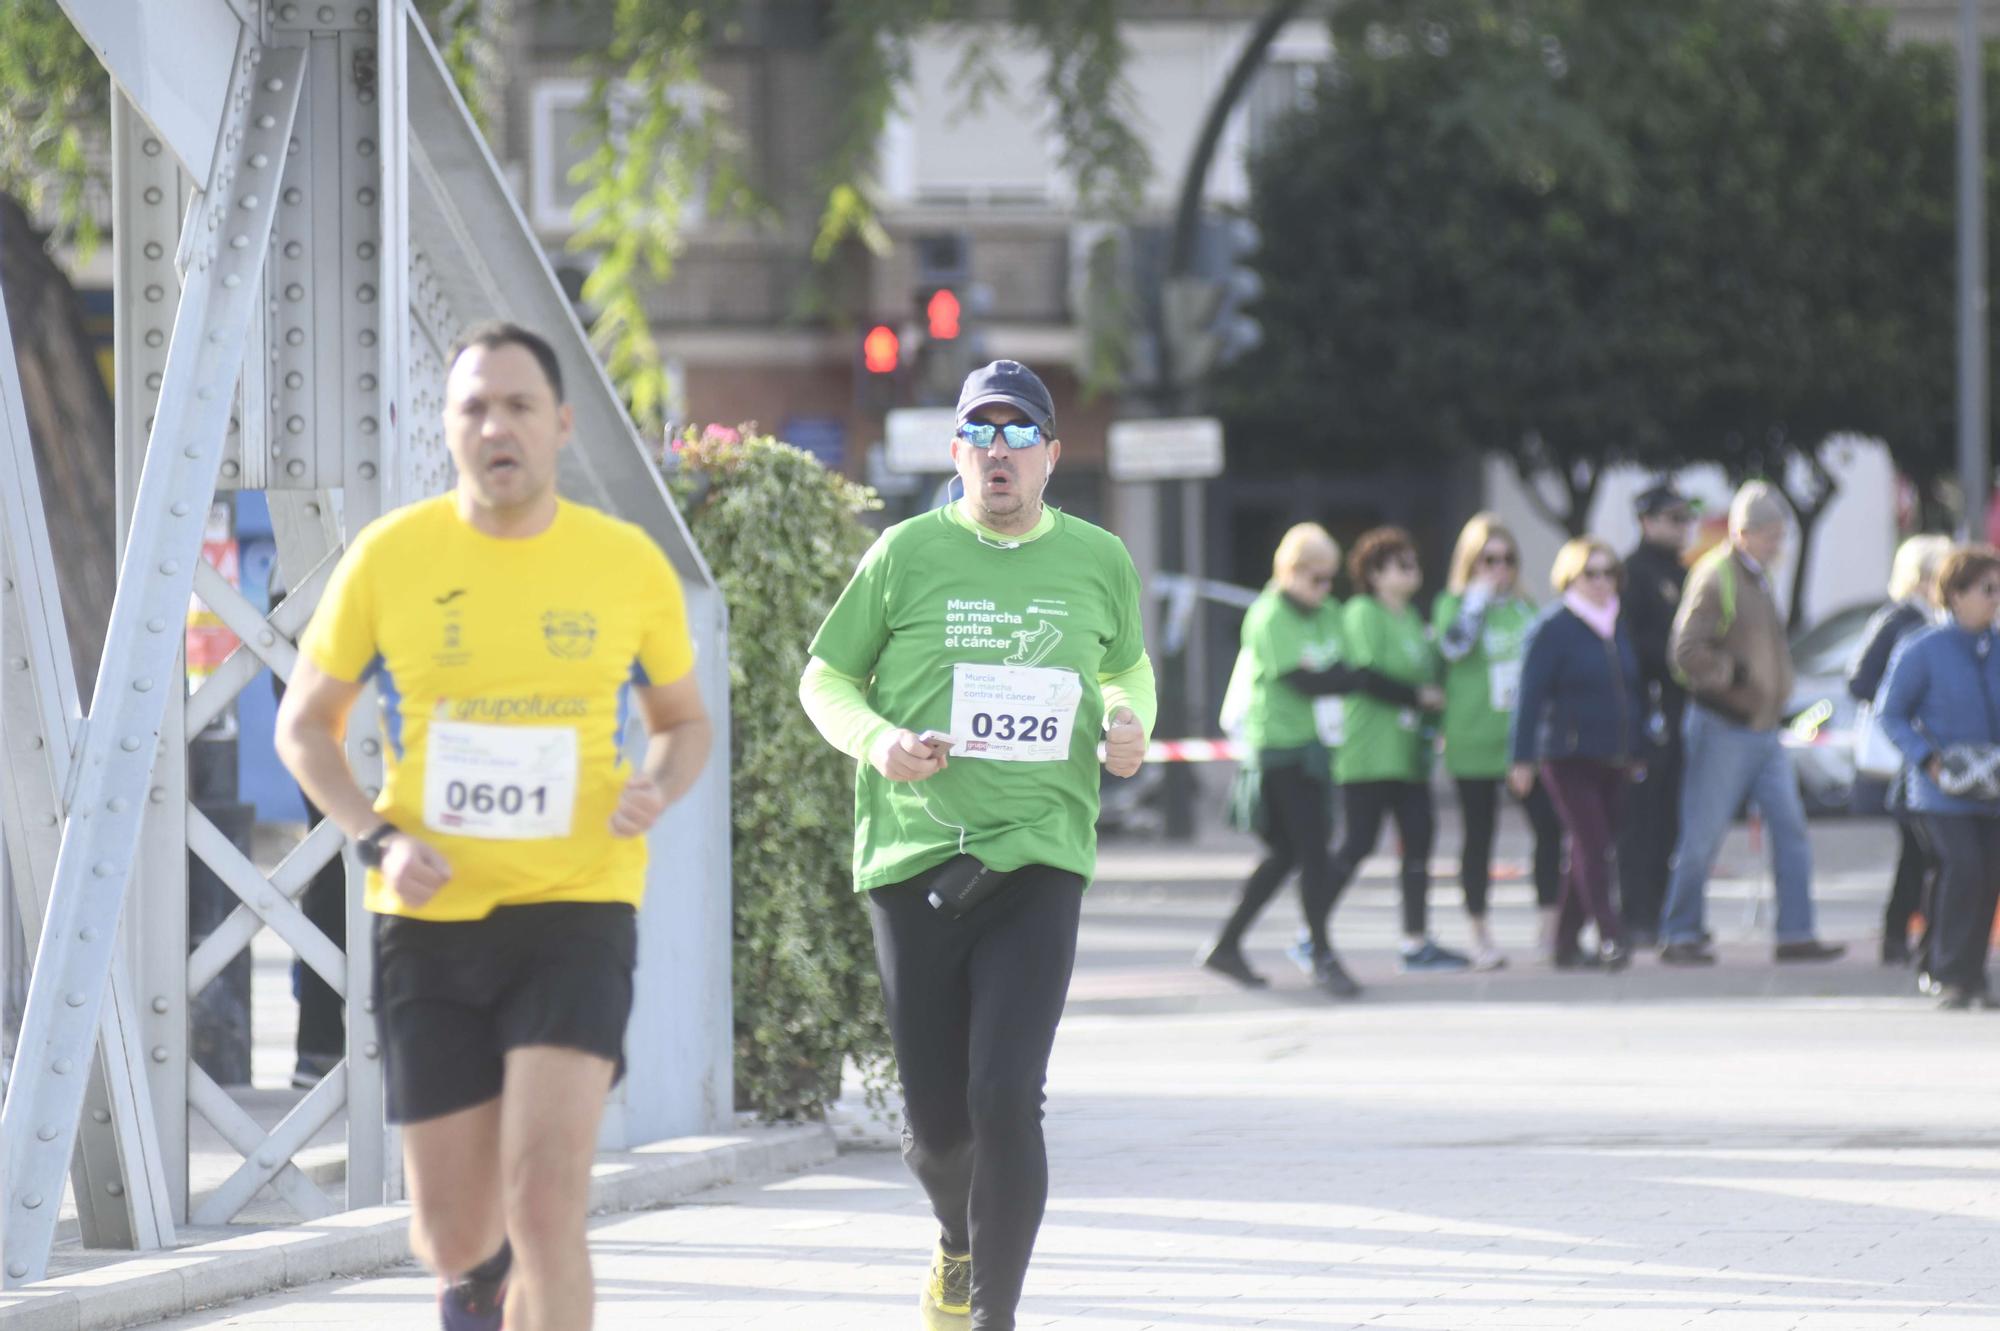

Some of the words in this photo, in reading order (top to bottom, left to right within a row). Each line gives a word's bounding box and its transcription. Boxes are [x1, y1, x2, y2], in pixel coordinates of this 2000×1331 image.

[947, 599, 995, 611] Murcia
[946, 613, 964, 622] en
[968, 612, 1022, 624] marcha
[945, 623, 992, 635] contra
[945, 636, 958, 647] el
[961, 636, 1012, 649] cáncer
[965, 673, 995, 682] Murcia
[964, 690, 993, 699] contra
[995, 692, 1003, 700] el
[972, 712, 1058, 742] 0326
[446, 780, 547, 815] 0601
